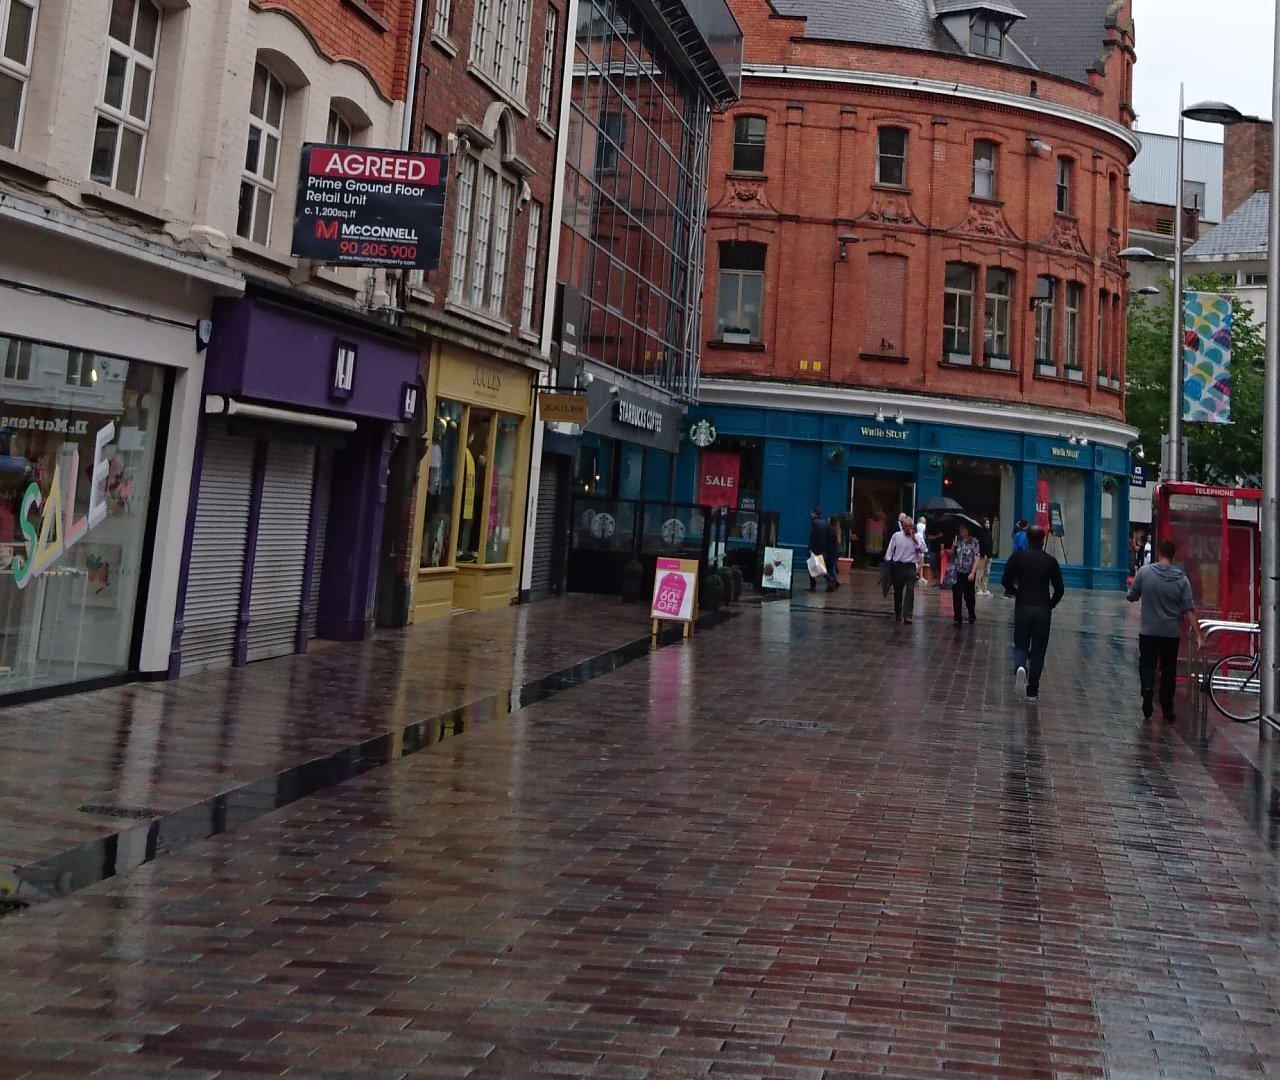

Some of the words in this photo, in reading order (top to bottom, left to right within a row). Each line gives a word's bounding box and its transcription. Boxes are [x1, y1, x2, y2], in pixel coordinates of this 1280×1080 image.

[325, 153, 426, 180] AGREED
[308, 176, 342, 190] Prime
[345, 180, 392, 195] Ground
[395, 184, 425, 197] Floor
[306, 190, 340, 203] Retail
[343, 193, 367, 206] Unit
[342, 223, 418, 240] McCONNELL
[340, 241, 358, 254] 90
[361, 243, 387, 257] 205
[391, 245, 417, 259] 900
[543, 404, 584, 414] JOULES
[705, 475, 734, 488] SALE
[1194, 487, 1234, 497] TELEPHONE
[12, 422, 116, 588] SALE
[657, 601, 678, 613] OFF
